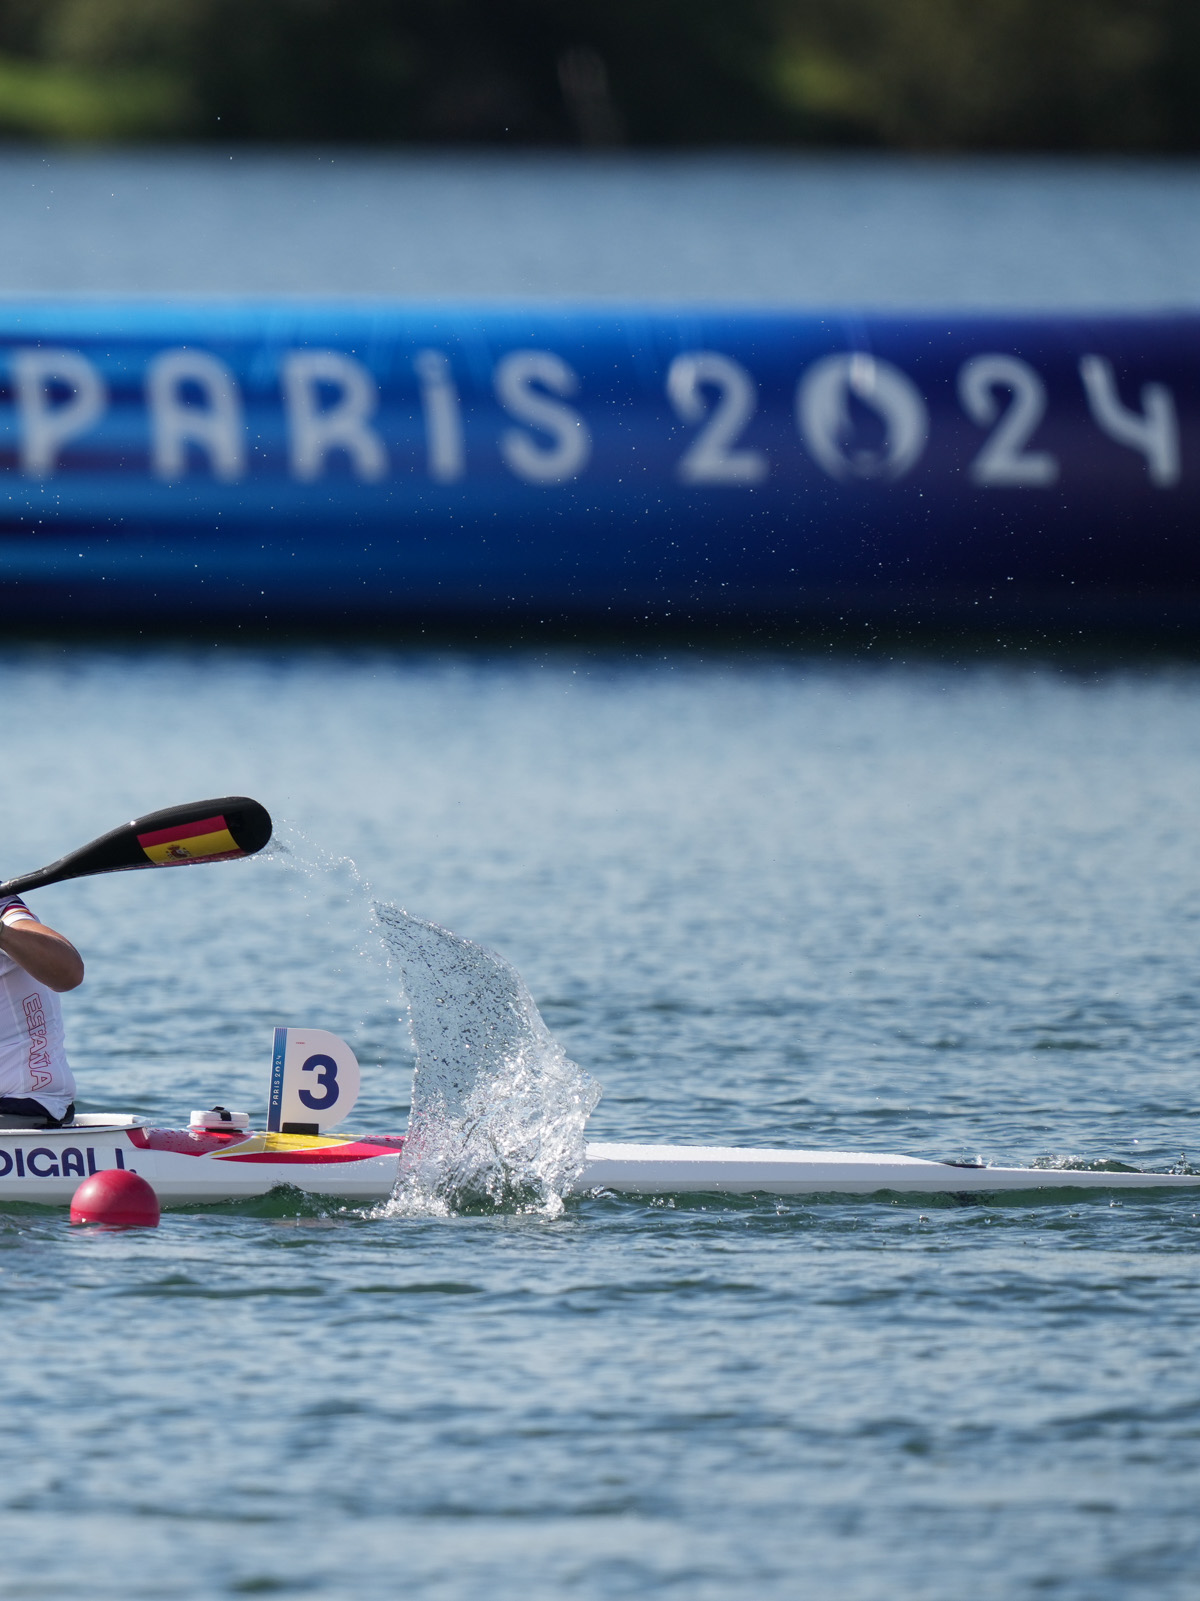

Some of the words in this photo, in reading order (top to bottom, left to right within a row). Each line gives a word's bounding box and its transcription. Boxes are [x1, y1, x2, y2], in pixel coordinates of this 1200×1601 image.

[9, 348, 589, 483] PARIS
[667, 351, 1180, 485] 2024
[22, 992, 52, 1091] ESPAÑA
[272, 1080, 280, 1105] PARIS
[298, 1054, 339, 1110] 3
